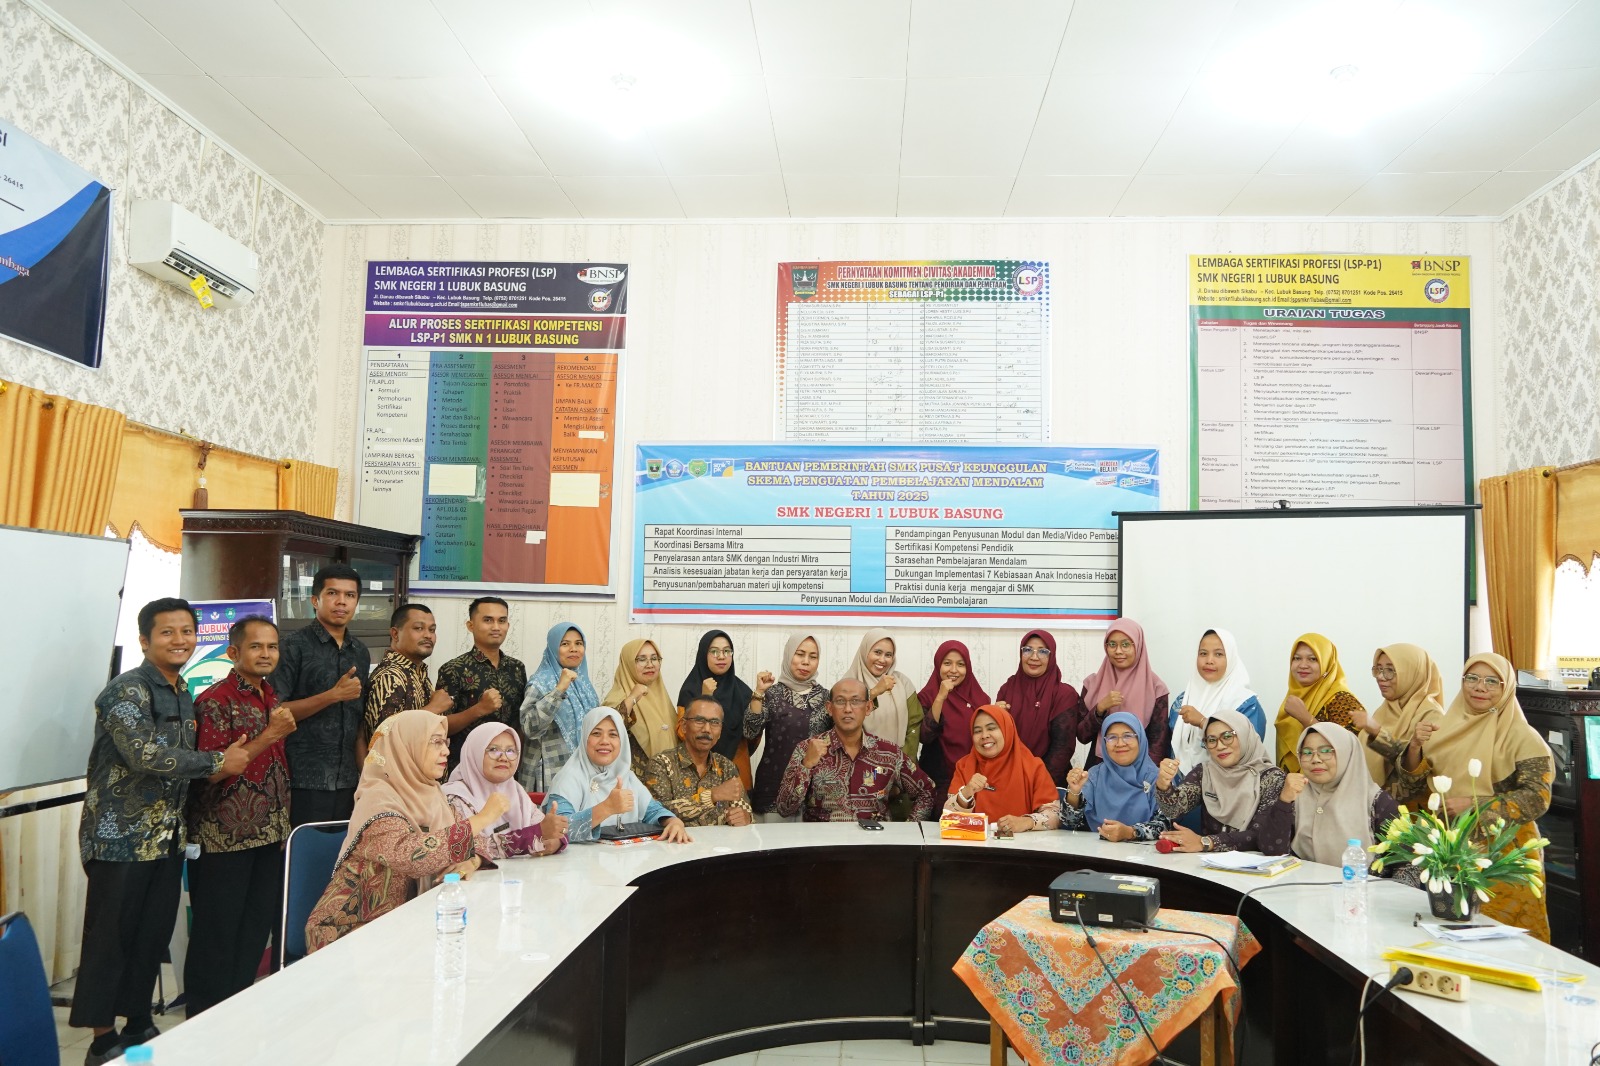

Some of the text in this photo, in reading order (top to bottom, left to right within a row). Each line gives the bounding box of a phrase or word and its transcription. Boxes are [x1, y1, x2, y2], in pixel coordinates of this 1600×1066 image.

[3, 174, 24, 190] 26415
[1198, 258, 1382, 271] LEMBAGA SERTIFIKASI PROFESI (LSP-P1)
[1424, 260, 1460, 272] BNSP
[375, 266, 557, 279] LEMBAGA SERTIFIKASI PROFESI (LSP)
[838, 266, 996, 278] PERNYATAAN KOMITMEN CIVITAS AKADEMIKA
[1018, 276, 1038, 284] LSP
[1198, 273, 1340, 284] SMK NEGERI 1 LUBUK BASUNG
[374, 280, 526, 292] SMK NEGERI 1 LUBUK BASUNG
[1264, 309, 1385, 319] URAIAN TUGAS
[388, 318, 603, 331] ALUR PROSES SERTIFIKASI KOMPETENSI
[410, 332, 579, 344] LSP-P1 SMK N 1 LUBUK BASUNG
[745, 462, 1048, 473] BANTUAN PEMERINTAH SMK PUSAT KEUNGGULAN
[748, 476, 1044, 487] SKEMA PENGUATAN PEMBELAJARAN MENDALAM
[852, 490, 928, 500] TAHUN 2025
[778, 507, 1003, 519] SMK NEGERI 1 LUBUK BASUNG
[654, 528, 674, 537] Rapat
[895, 530, 950, 539] Pendampingan
[953, 530, 999, 540] Penyusunan
[1002, 530, 1024, 538] Modul
[1042, 531, 1088, 539] Media/Video
[1090, 532, 1118, 540] Pembel
[654, 540, 692, 548] Koordinasi
[935, 543, 979, 552] Kompetensi
[654, 554, 700, 564] Penyelarasan
[726, 554, 742, 562] SMK
[744, 555, 770, 564] dengan
[894, 556, 1027, 566] Sarasehan Pembelajaran Mendalam
[683, 567, 722, 575] kesesuaian
[724, 567, 750, 577] jabatan
[752, 568, 769, 577] kerja
[786, 569, 828, 578] persyaratan
[830, 569, 848, 578] kerja
[894, 569, 932, 579] Dukungan
[935, 570, 985, 579] Implementasi
[994, 570, 1032, 579] Kebiasaan
[1035, 571, 1054, 579] Anak
[1056, 572, 1092, 580] Indonesia
[1095, 572, 1117, 580] Hebat
[653, 580, 746, 590] Penyusunan/pembaharuan
[772, 582, 780, 590] uji
[783, 582, 824, 591] kompetensi
[925, 583, 946, 591] dunia
[948, 584, 966, 594] kerja
[970, 584, 1006, 594] mengajar
[1008, 584, 1014, 592] di
[1017, 584, 1034, 592] SMK
[801, 594, 846, 604] Penyusunan
[890, 595, 935, 604] Media/Video
[937, 596, 988, 606] Pembelajaran
[200, 624, 228, 633] LUBUK
